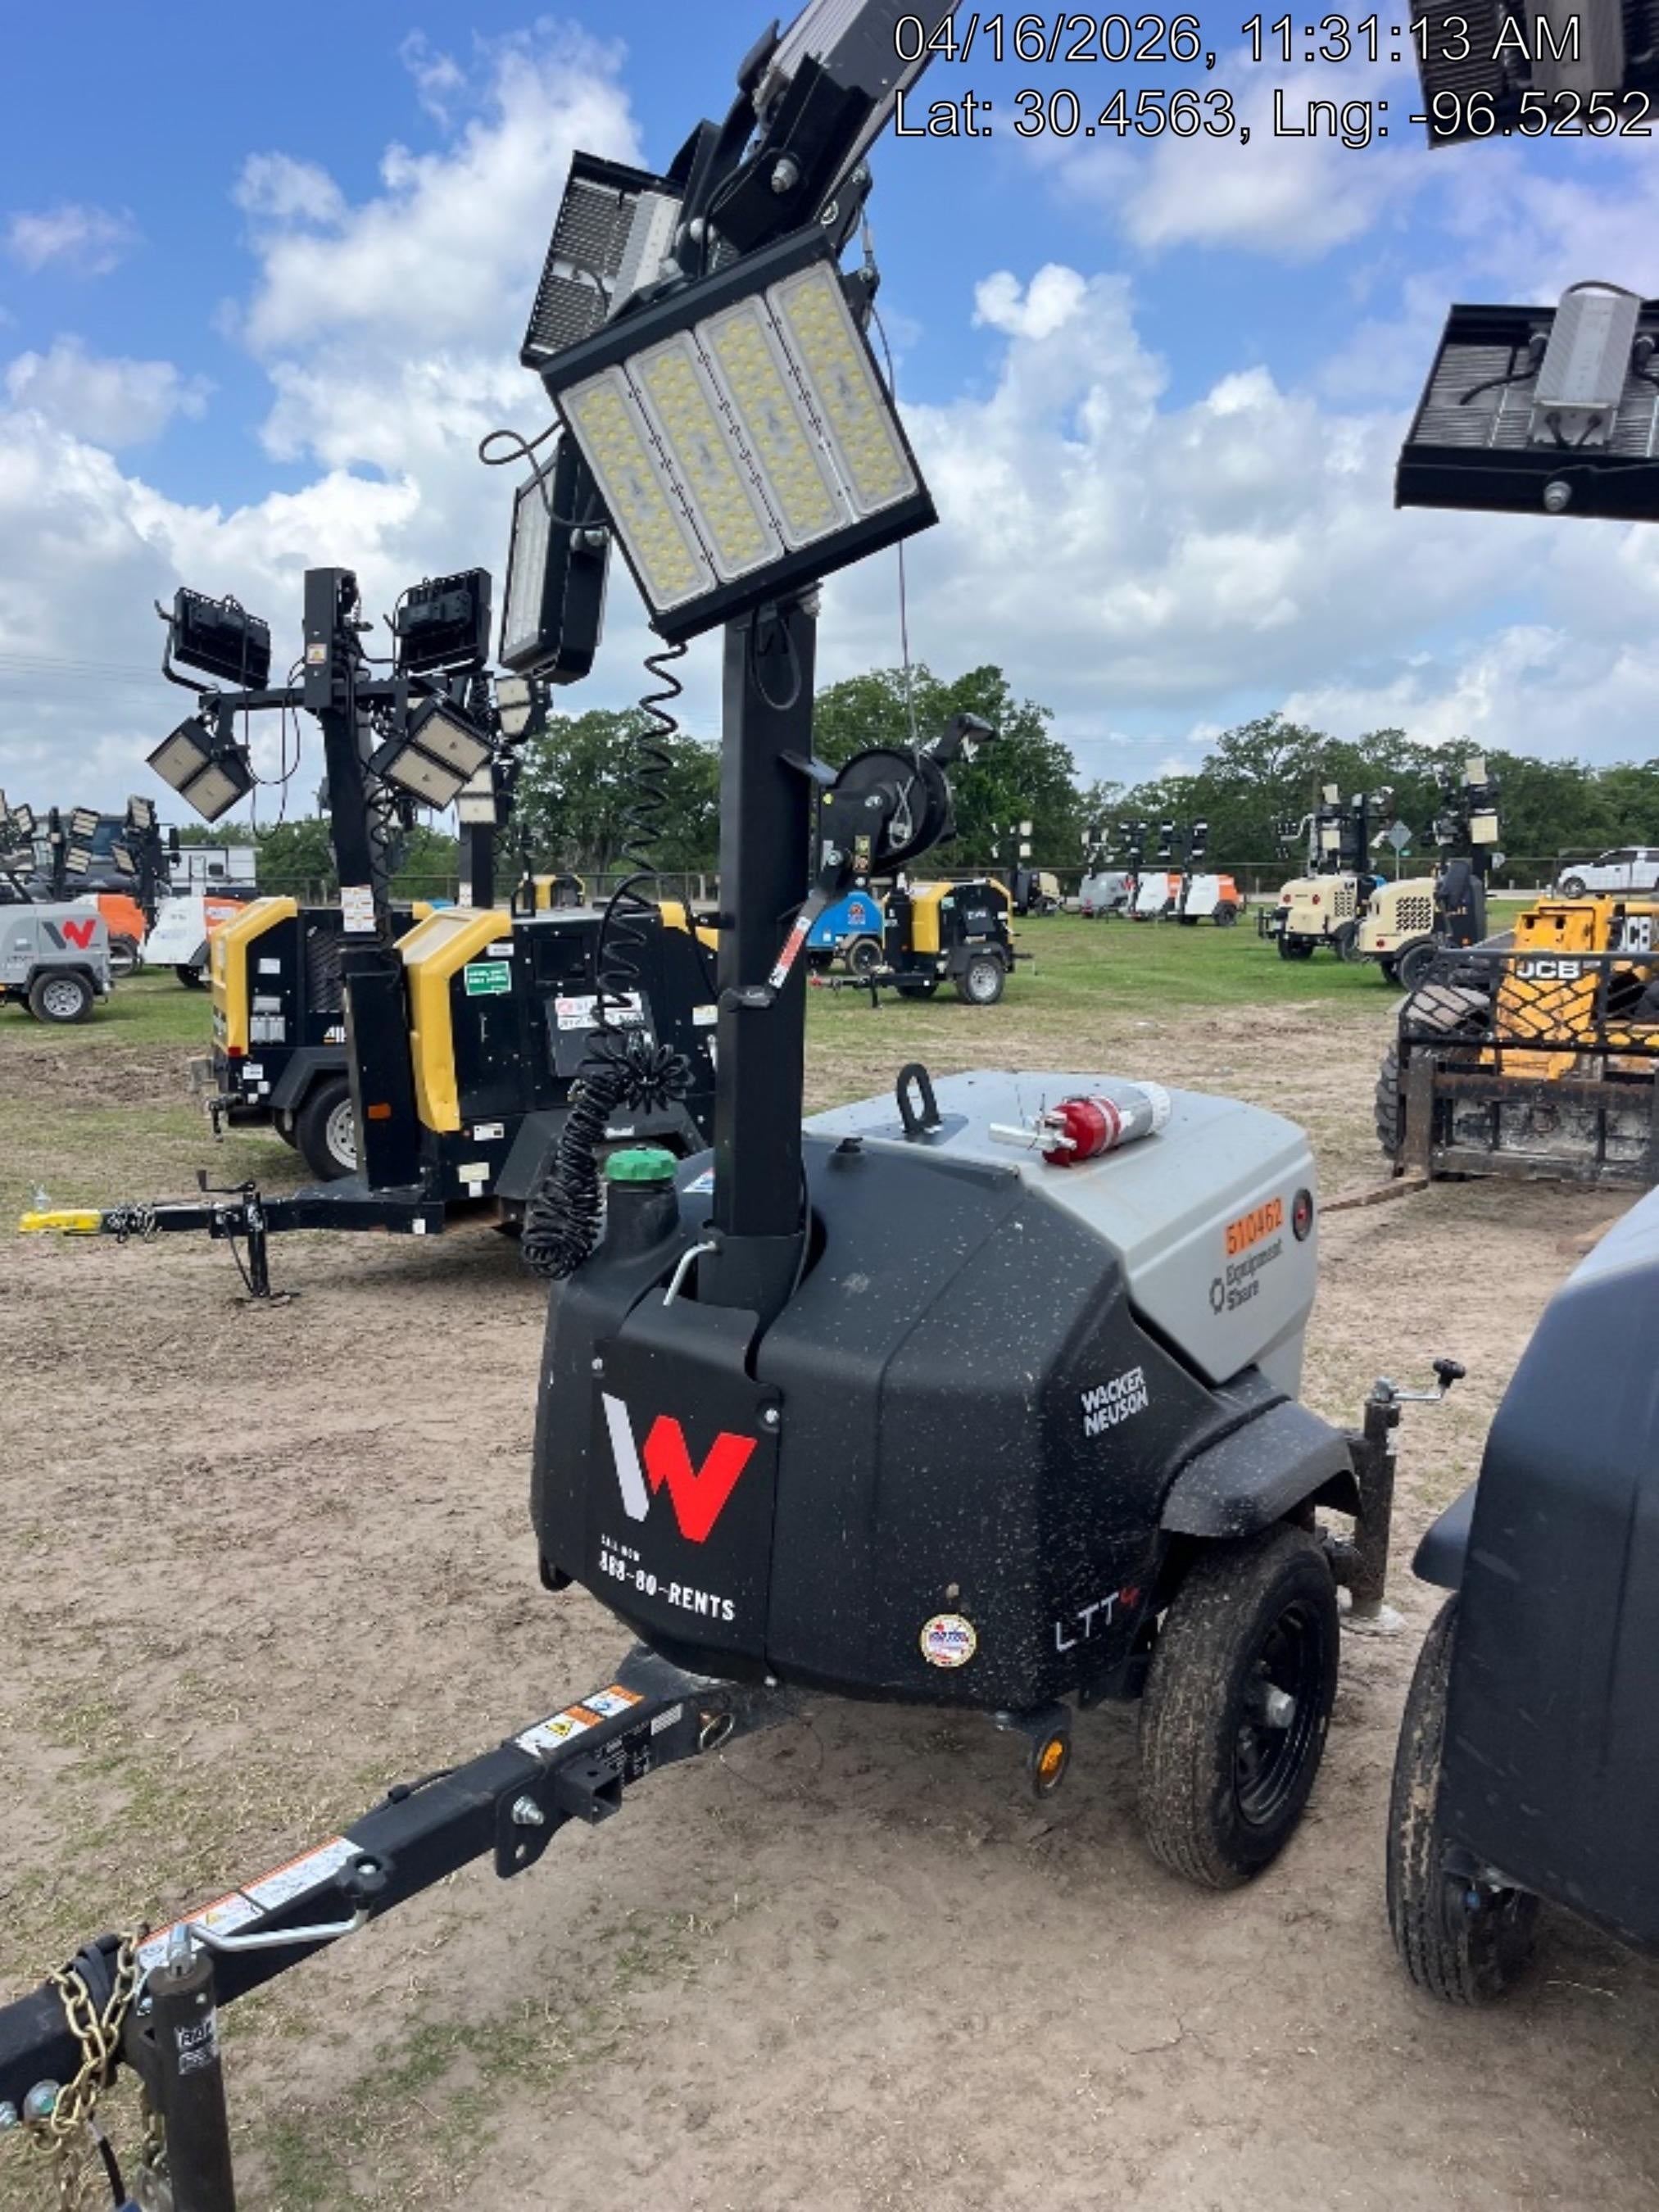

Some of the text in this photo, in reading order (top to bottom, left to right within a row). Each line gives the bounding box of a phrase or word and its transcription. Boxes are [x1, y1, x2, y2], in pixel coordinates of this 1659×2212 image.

[1516, 960, 1580, 979] JCB
[1226, 1236, 1284, 1286] Equipment
[1226, 1280, 1260, 1312] Share
[1081, 1366, 1146, 1414] WACKER
[1083, 1385, 1149, 1438] NEUSON
[600, 1549, 736, 1620] 888-80-RENTS
